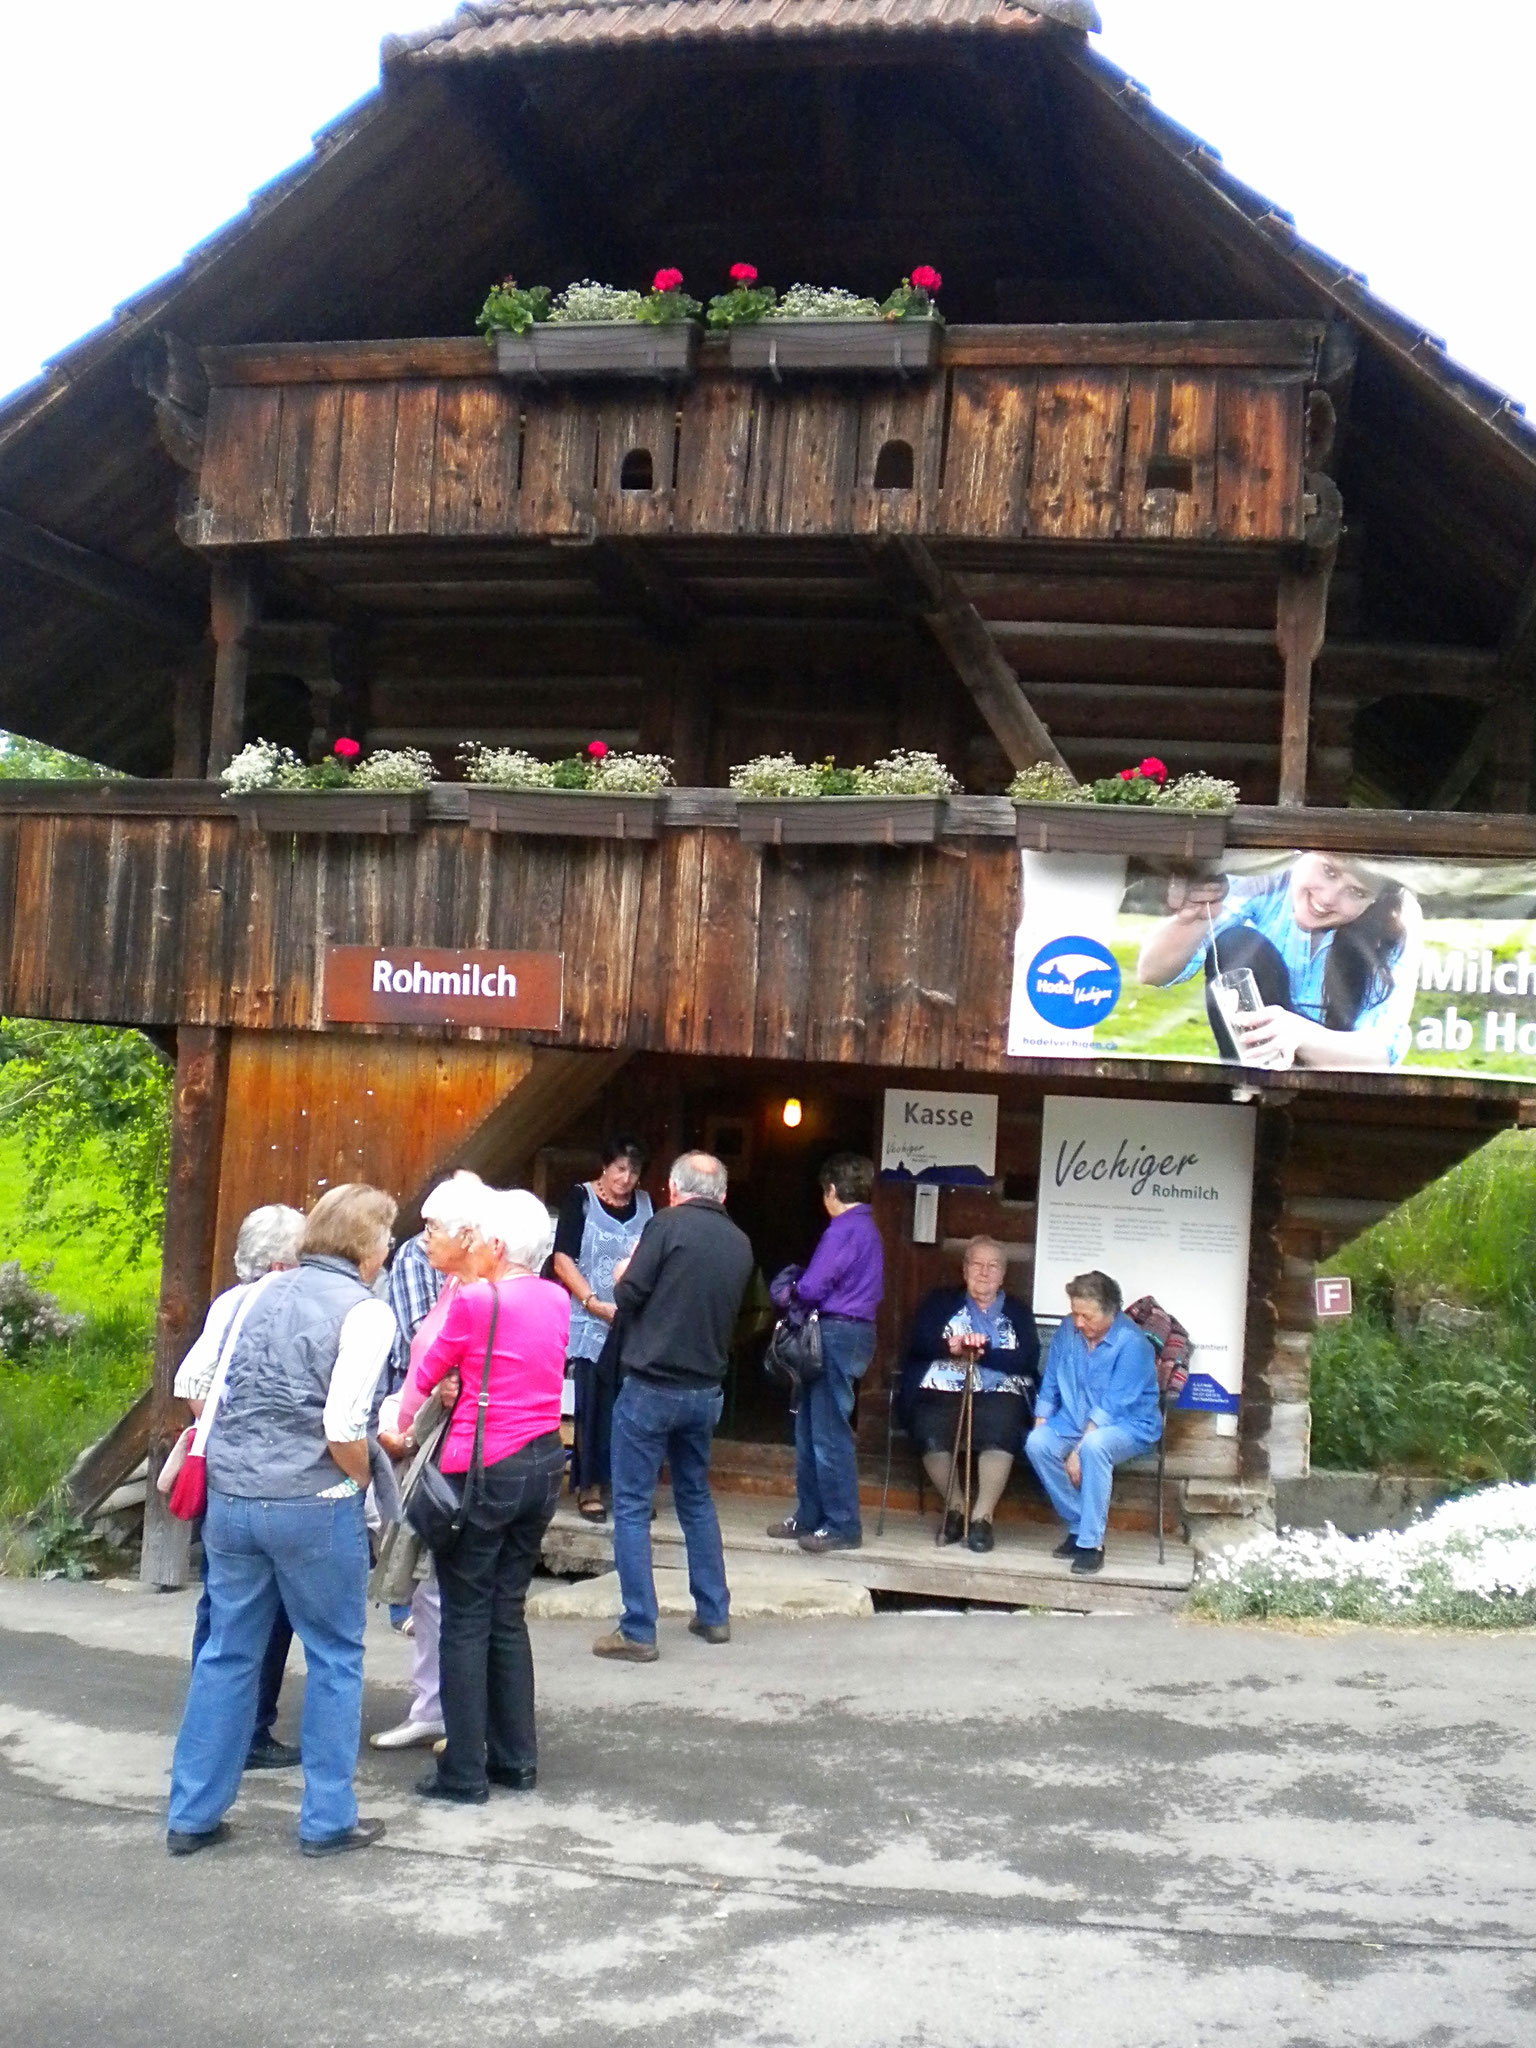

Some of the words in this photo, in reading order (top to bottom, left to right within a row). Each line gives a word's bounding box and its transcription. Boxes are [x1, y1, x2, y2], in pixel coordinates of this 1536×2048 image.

[373, 959, 516, 997] Rohmilch
[1036, 979, 1075, 995] Hodel
[1420, 949, 1536, 995] Milch
[1416, 1006, 1473, 1050] ab
[904, 1102, 974, 1127] Kasse
[1055, 1139, 1199, 1196] Vechiger
[1152, 1184, 1219, 1200] Rohmilch
[1323, 1284, 1343, 1309] F
